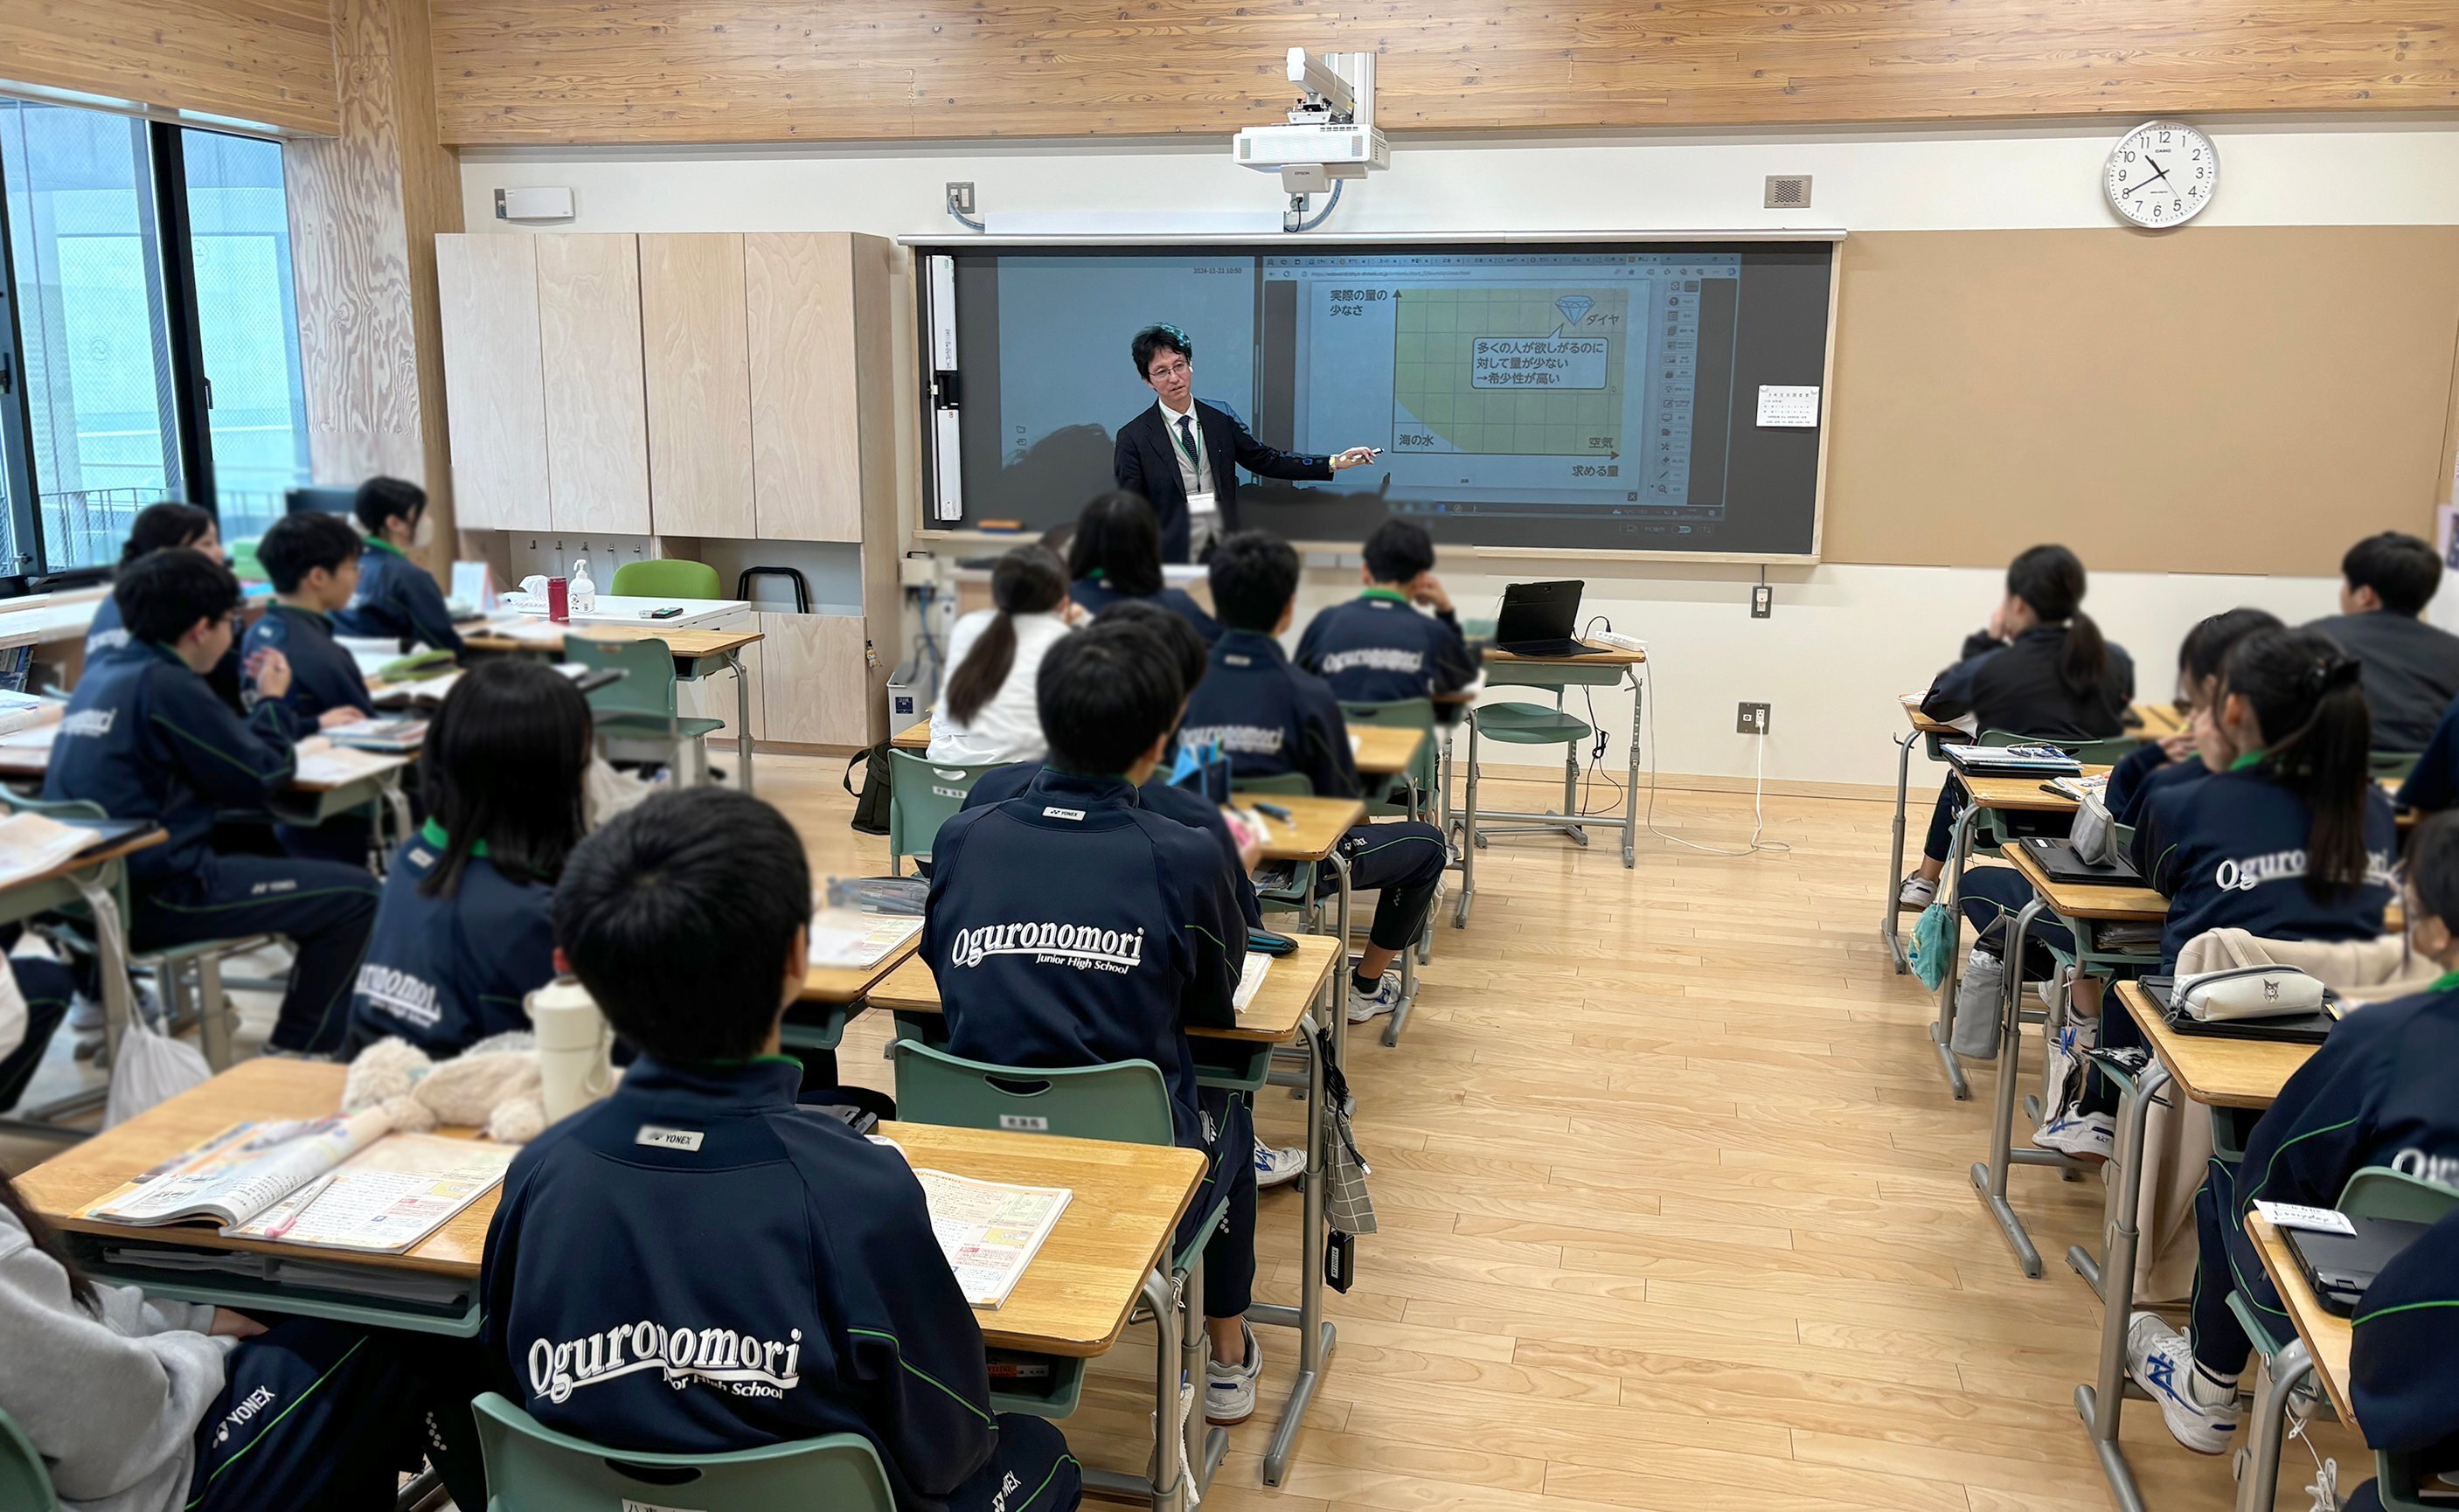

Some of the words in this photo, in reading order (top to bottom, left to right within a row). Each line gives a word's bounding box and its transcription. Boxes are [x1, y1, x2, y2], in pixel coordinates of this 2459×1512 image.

[2140, 137, 2150, 149] 11
[2159, 131, 2171, 143] 12
[2123, 151, 2136, 163] 10
[2192, 149, 2201, 161] 2
[2118, 170, 2127, 181] 9
[2196, 167, 2204, 179] 3
[2122, 187, 2129, 200] 8
[2188, 185, 2197, 198] 4
[2136, 200, 2143, 212] 7
[2153, 205, 2162, 217] 6
[2173, 199, 2182, 212] 5
[1330, 289, 1387, 302] 実際の量の
[1330, 304, 1363, 316] 少なさ
[1587, 314, 1619, 326] ダイヤ
[1477, 342, 1604, 354] 多くの人が欲しがるのに
[1476, 357, 1568, 369] 対して量が少ない
[1399, 434, 1434, 446] 海の水
[1588, 437, 1614, 448] 空気
[1572, 465, 1619, 477] 求める量
[951, 921, 1145, 968] Oguronomori
[1036, 953, 1066, 965] Junior
[1067, 956, 1093, 970] High
[1094, 961, 1129, 974] School
[665, 1134, 692, 1145] YONEX
[732, 1381, 783, 1400] School
[226, 1384, 276, 1426] YONEX
